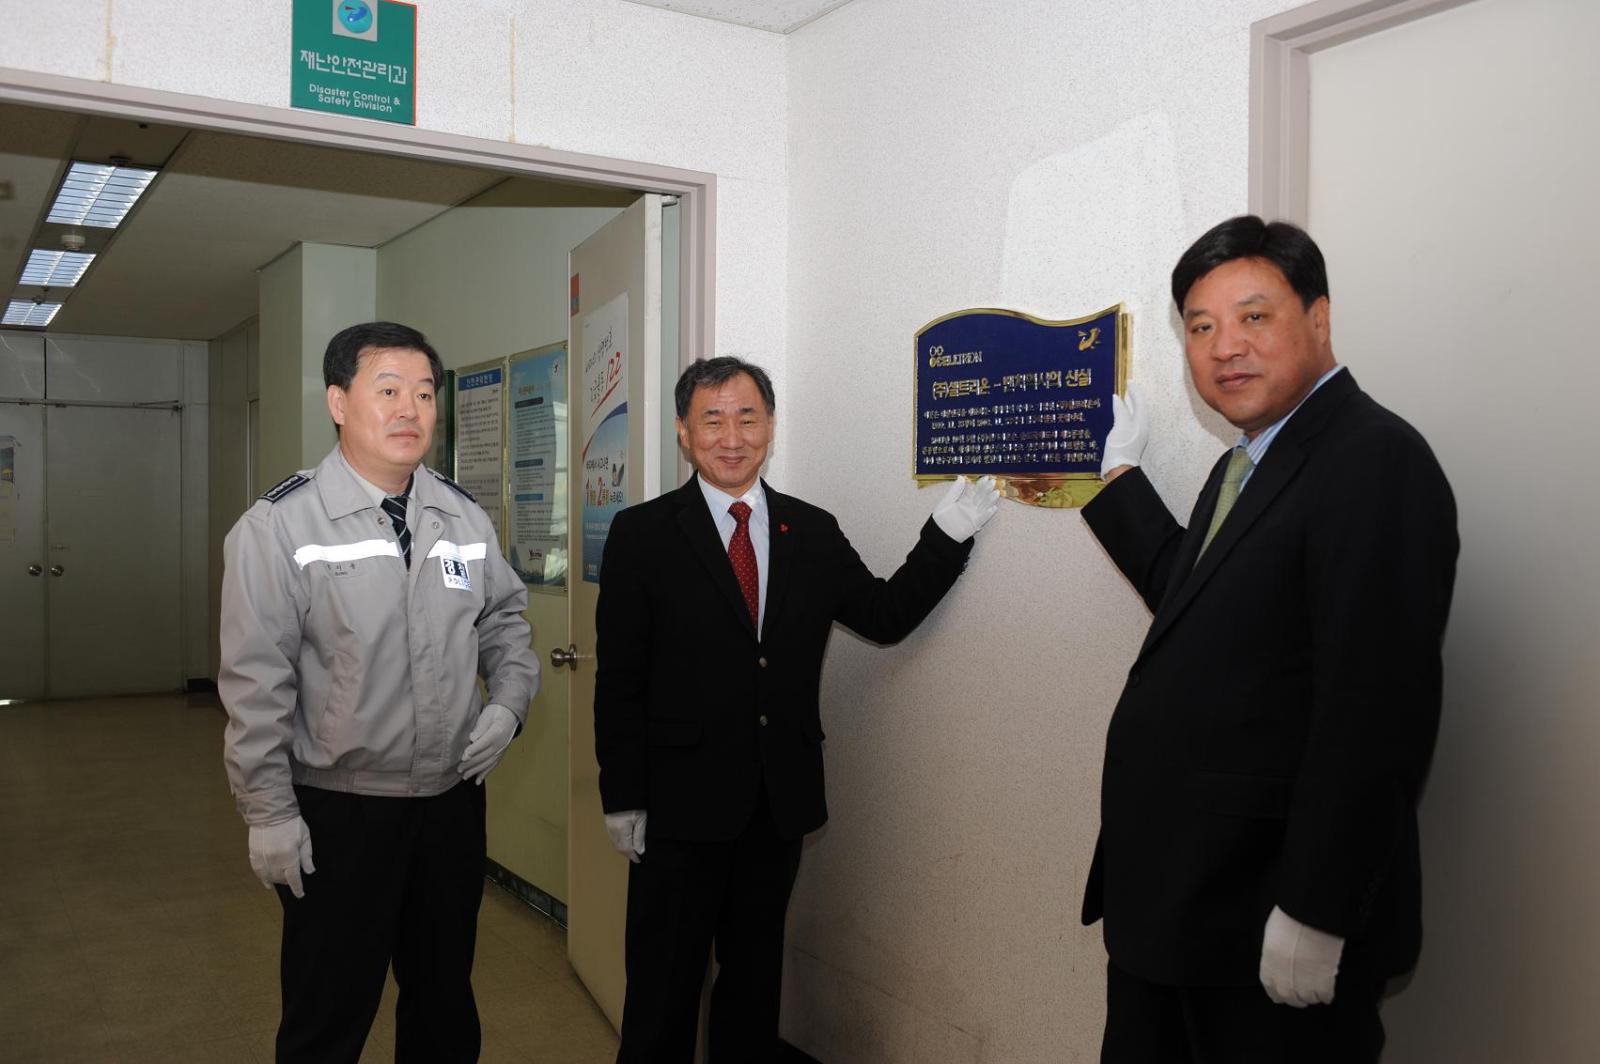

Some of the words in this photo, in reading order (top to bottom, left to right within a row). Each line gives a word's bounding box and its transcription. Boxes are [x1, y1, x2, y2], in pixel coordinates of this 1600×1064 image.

[300, 49, 408, 85] 재난안전관리과
[309, 83, 350, 98] Disaster
[353, 90, 390, 104] Control
[394, 97, 401, 106] &
[318, 94, 351, 107] Safety
[354, 100, 393, 113] Division
